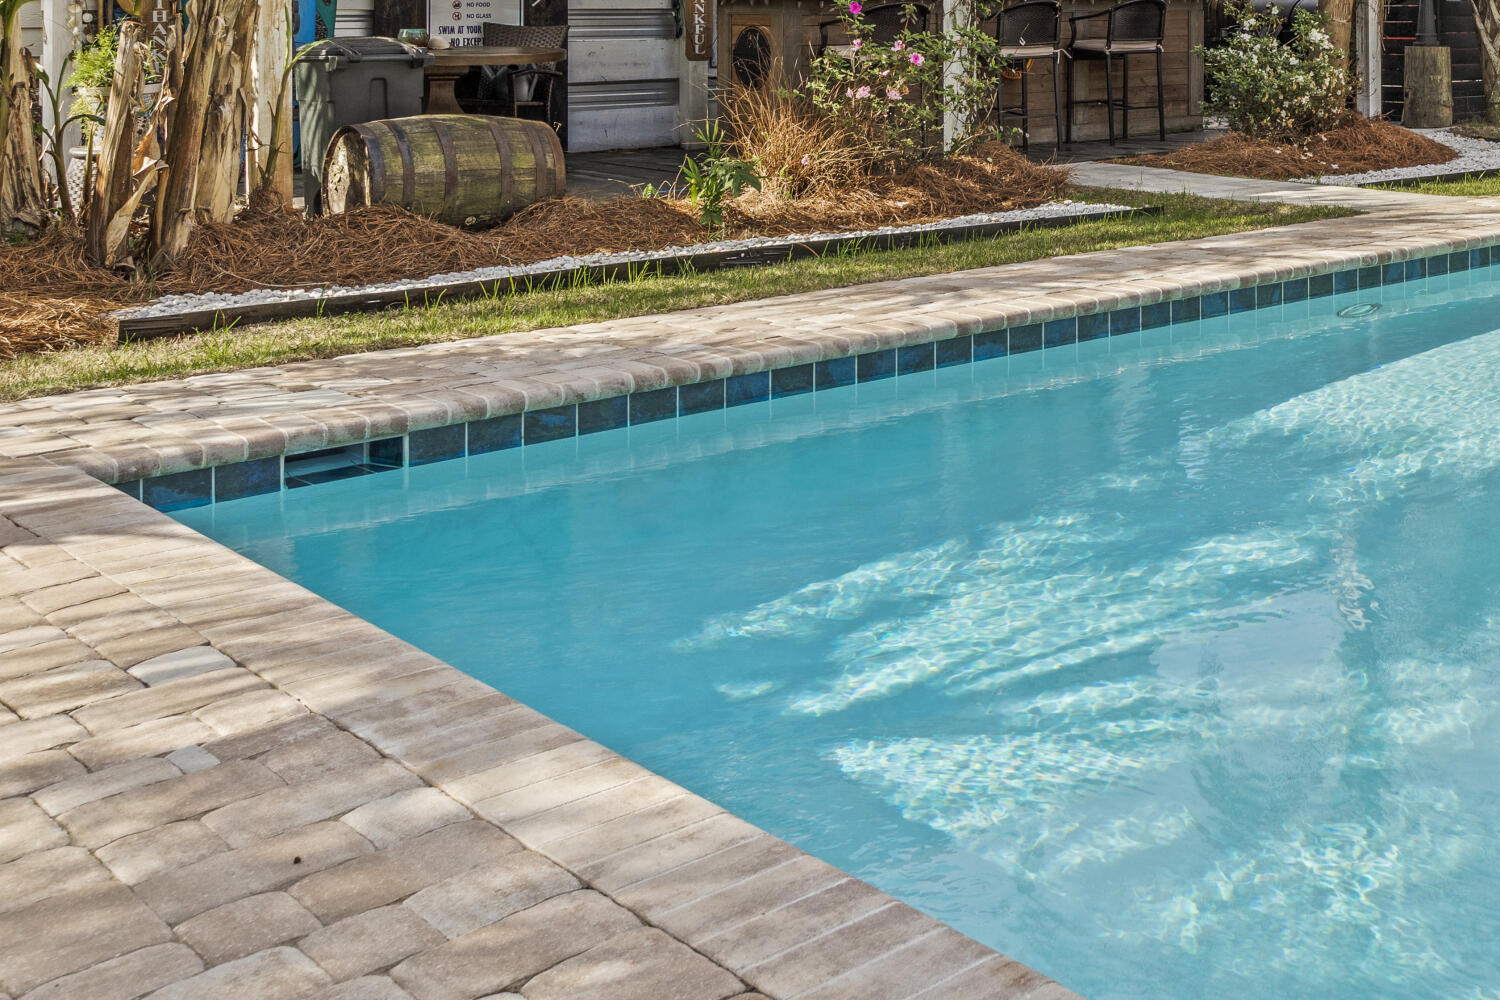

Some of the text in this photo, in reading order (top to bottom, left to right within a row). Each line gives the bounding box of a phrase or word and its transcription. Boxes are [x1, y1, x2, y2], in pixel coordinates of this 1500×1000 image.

[438, 25, 482, 35] SWIM AT YOUR
[450, 37, 484, 48] NO EXCEP
